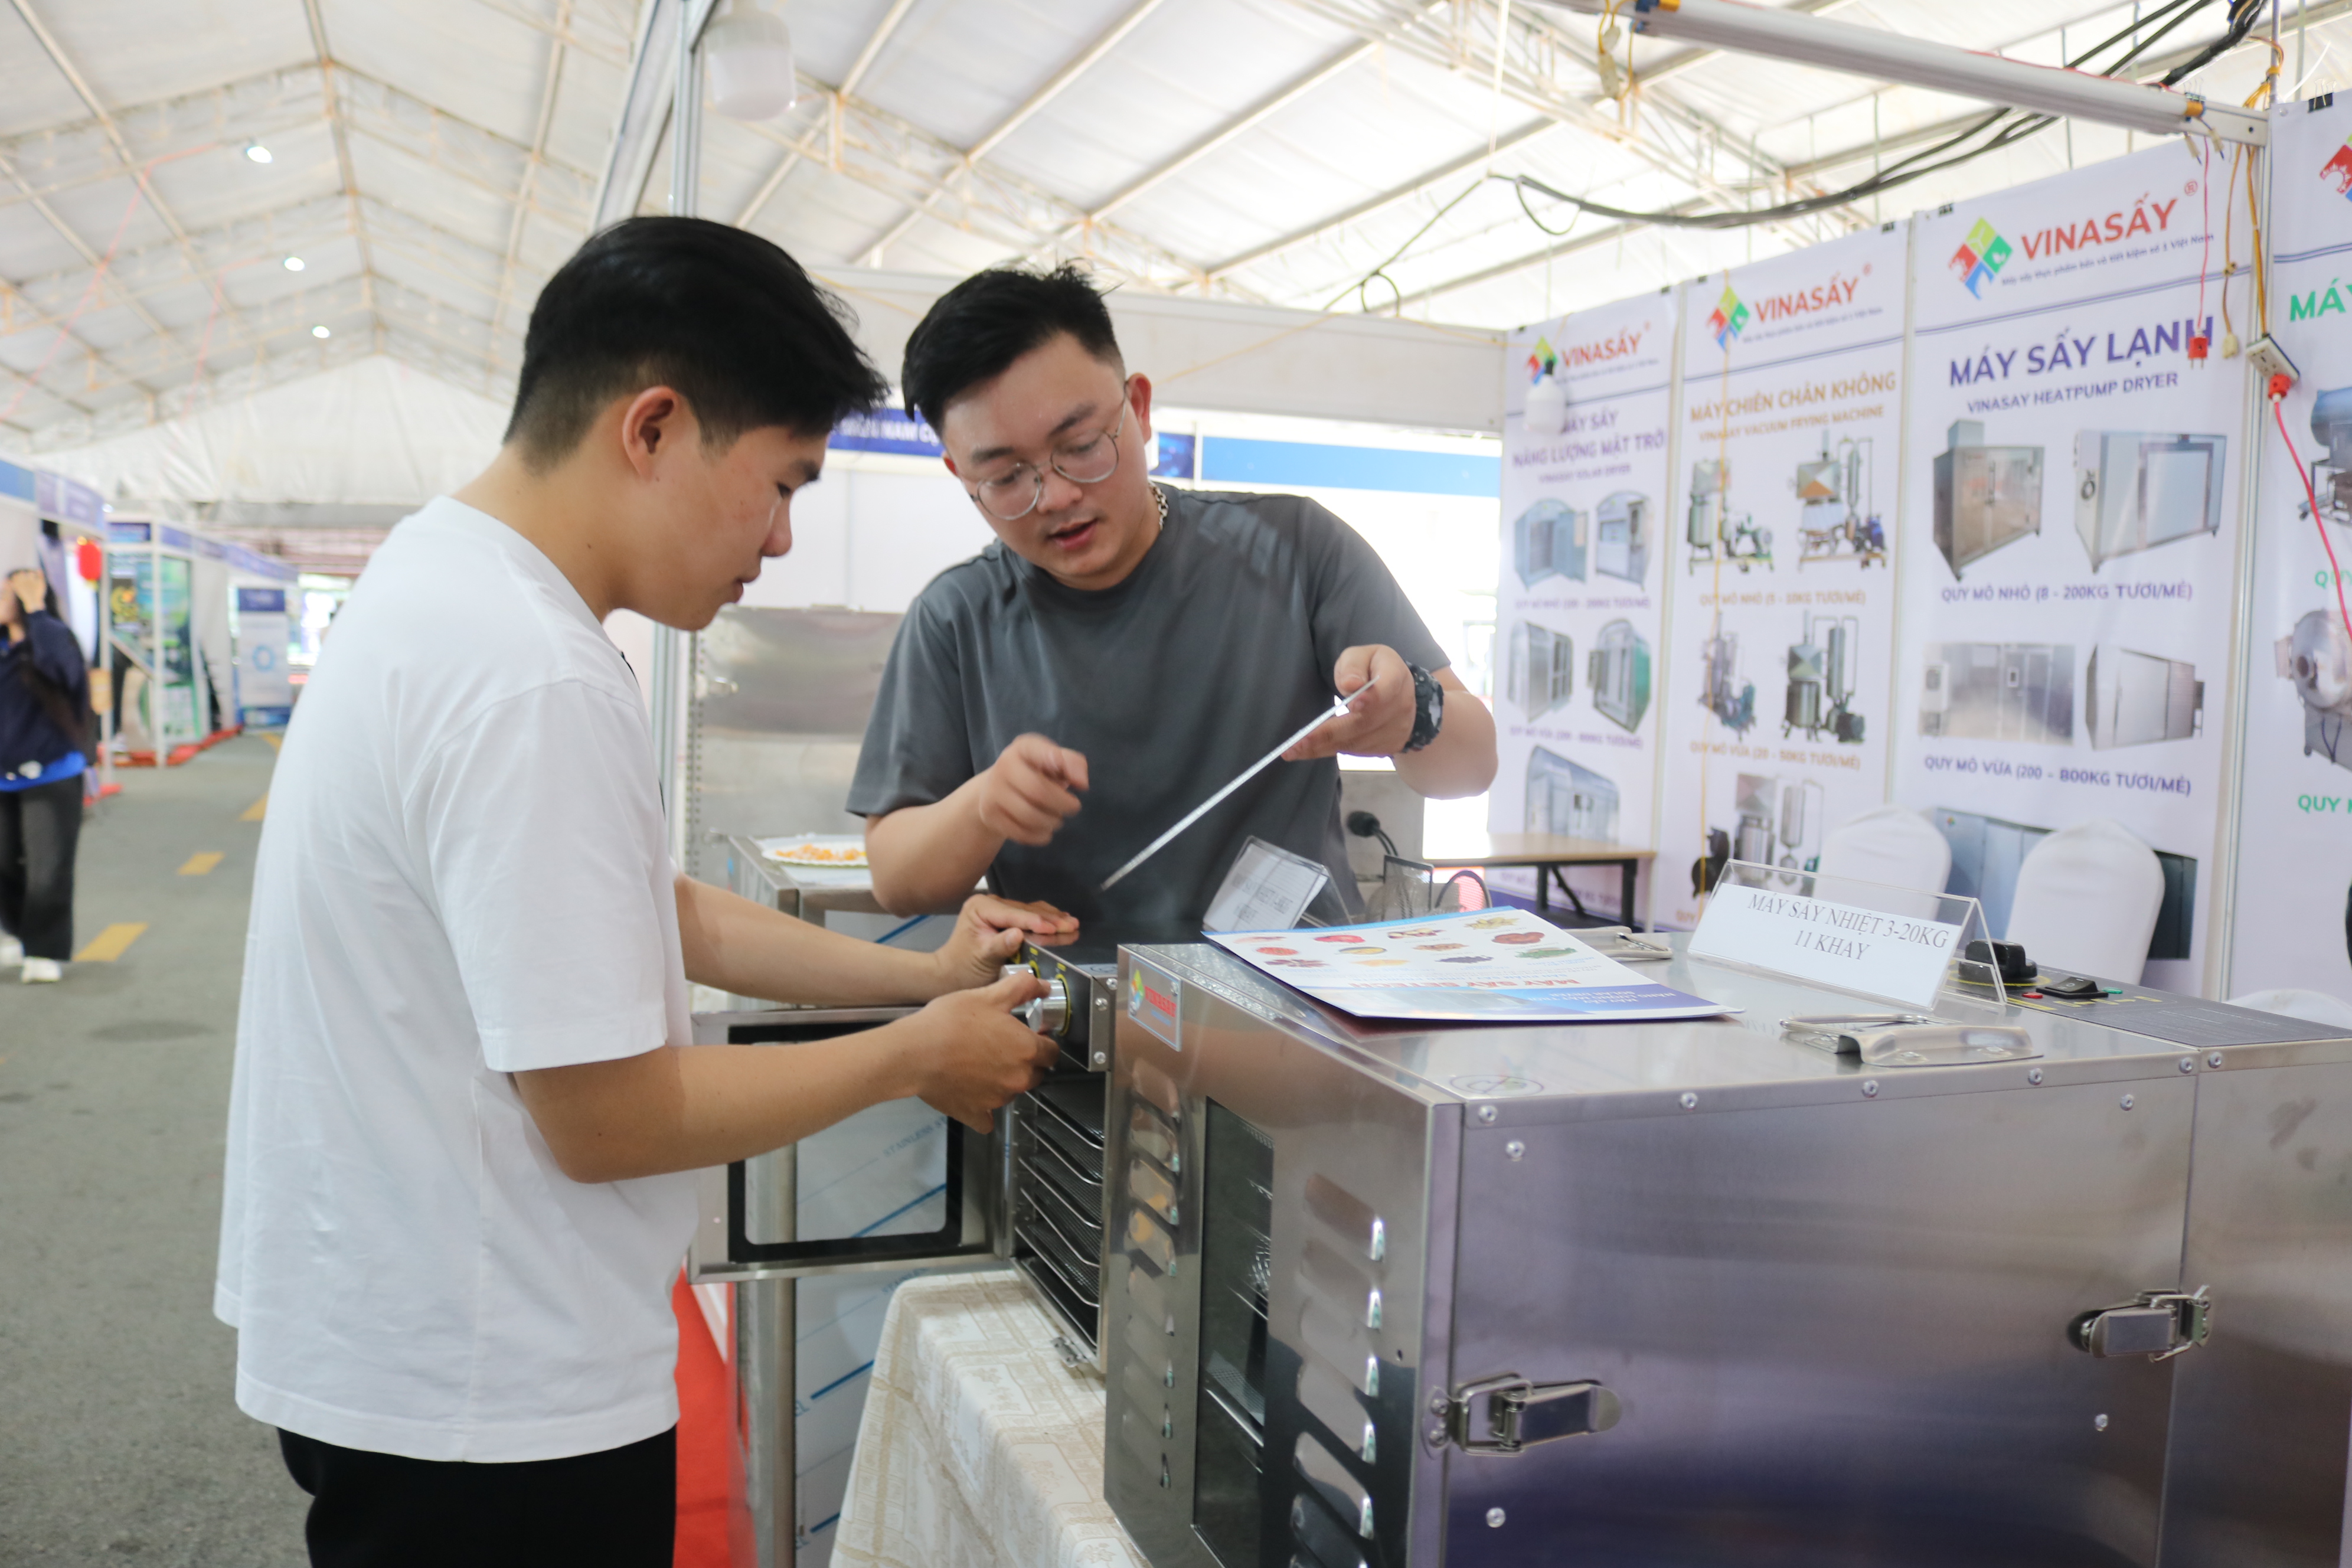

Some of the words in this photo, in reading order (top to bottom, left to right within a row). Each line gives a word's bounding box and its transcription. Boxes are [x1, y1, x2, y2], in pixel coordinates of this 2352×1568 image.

[2021, 192, 2178, 260] VINASẤY
[2171, 237, 2188, 249] Việt
[2191, 233, 2214, 245] Nam
[1755, 271, 1858, 322] VINASẤY
[2289, 277, 2352, 322] MÁ
[1562, 326, 1642, 368] VINASẤY
[1949, 345, 2017, 387] MÁY
[2027, 329, 2097, 373] SẤY
[2107, 316, 2213, 367] LẠNH
[1831, 371, 1896, 400] KHÔNG
[1968, 390, 2030, 413] VINASAY
[2034, 381, 2118, 406] HEATPUMP
[2124, 373, 2178, 393] DRYER
[1832, 405, 1885, 423] MACHINE
[1942, 587, 1968, 602] QUY
[1973, 584, 1993, 600] MÔ
[2064, 585, 2109, 600] 200KG
[1925, 755, 1952, 770] QUY
[1956, 757, 1978, 773] MÔ
[2298, 793, 2341, 815] QUY
[1747, 893, 1788, 915] MÁY
[1788, 900, 1825, 922] SẤY
[1828, 908, 1883, 936] NHIỆT
[1883, 920, 1949, 948] 3-20KG
[1794, 930, 1812, 948] 11
[1815, 934, 1871, 961] KHAY
